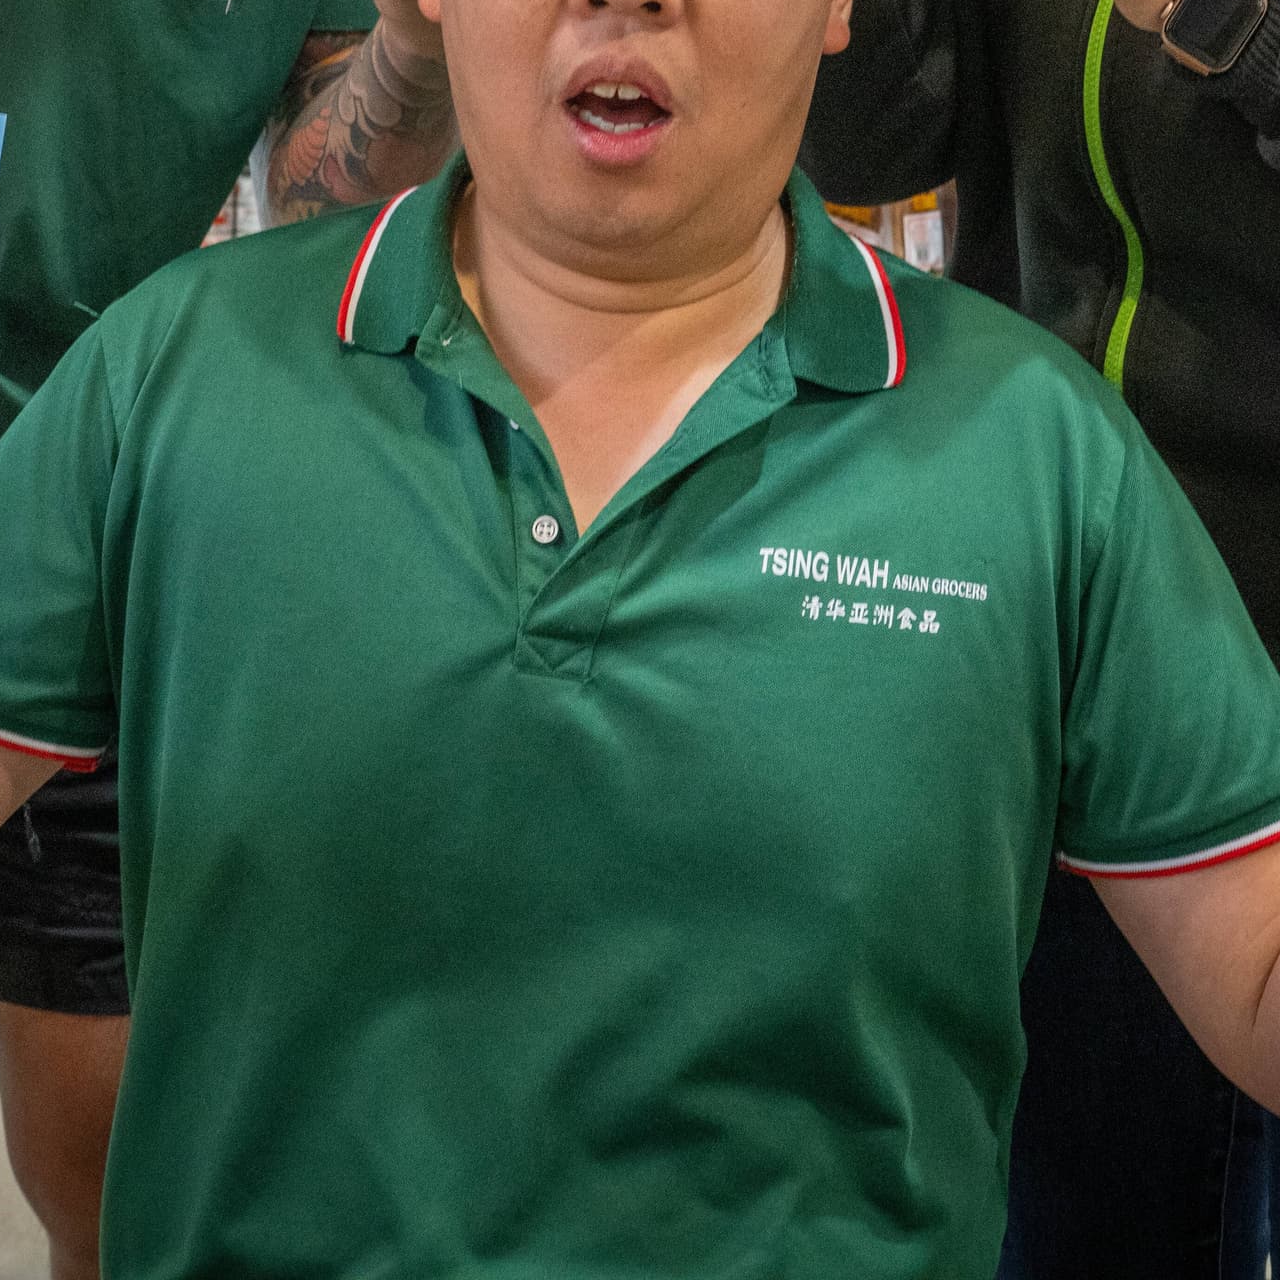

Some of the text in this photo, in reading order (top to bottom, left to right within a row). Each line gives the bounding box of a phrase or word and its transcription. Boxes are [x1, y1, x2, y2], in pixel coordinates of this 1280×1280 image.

[759, 547, 988, 601] TSING WAH ASIAN GROCERS
[802, 595, 940, 634] 清华亚洲食品
